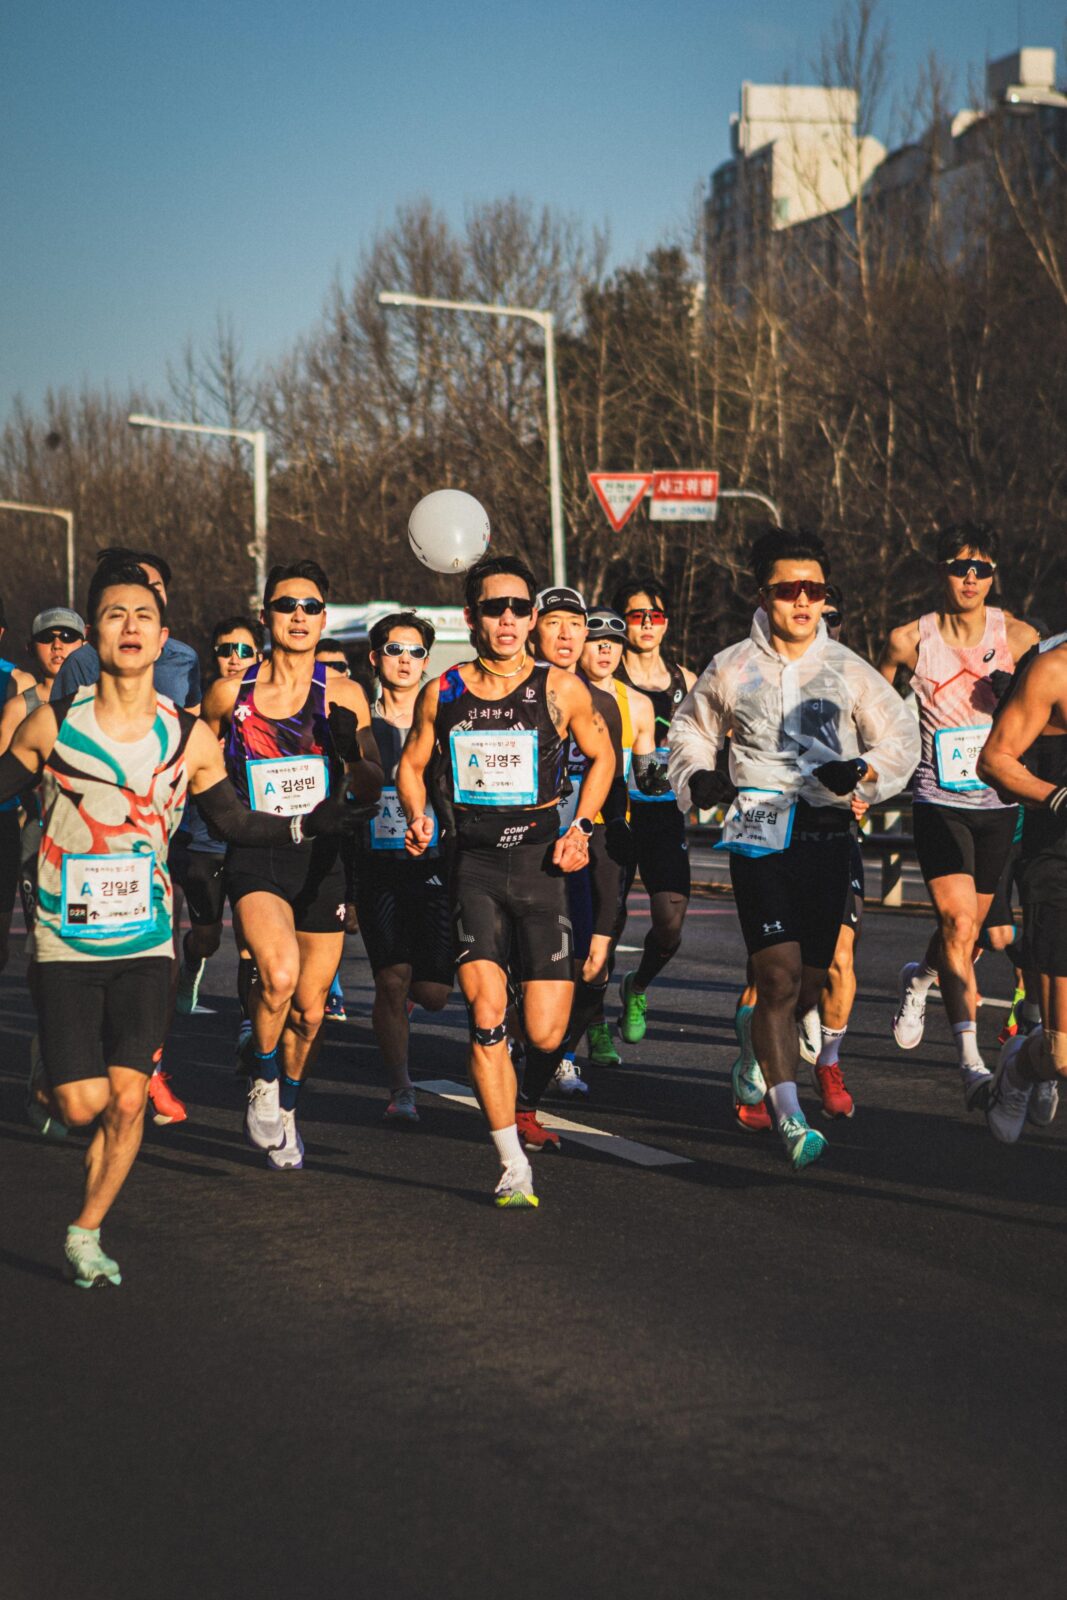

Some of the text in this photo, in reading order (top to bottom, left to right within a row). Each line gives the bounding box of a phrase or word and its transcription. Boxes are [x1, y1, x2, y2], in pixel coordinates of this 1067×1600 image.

[468, 753, 521, 768] A 김영주
[952, 748, 962, 760] A
[264, 776, 316, 795] A 김성민
[382, 806, 392, 818] A
[745, 809, 778, 825] 신문섭
[503, 825, 529, 835] COMP
[499, 834, 524, 842] RESS
[80, 880, 140, 897] A 김일호
